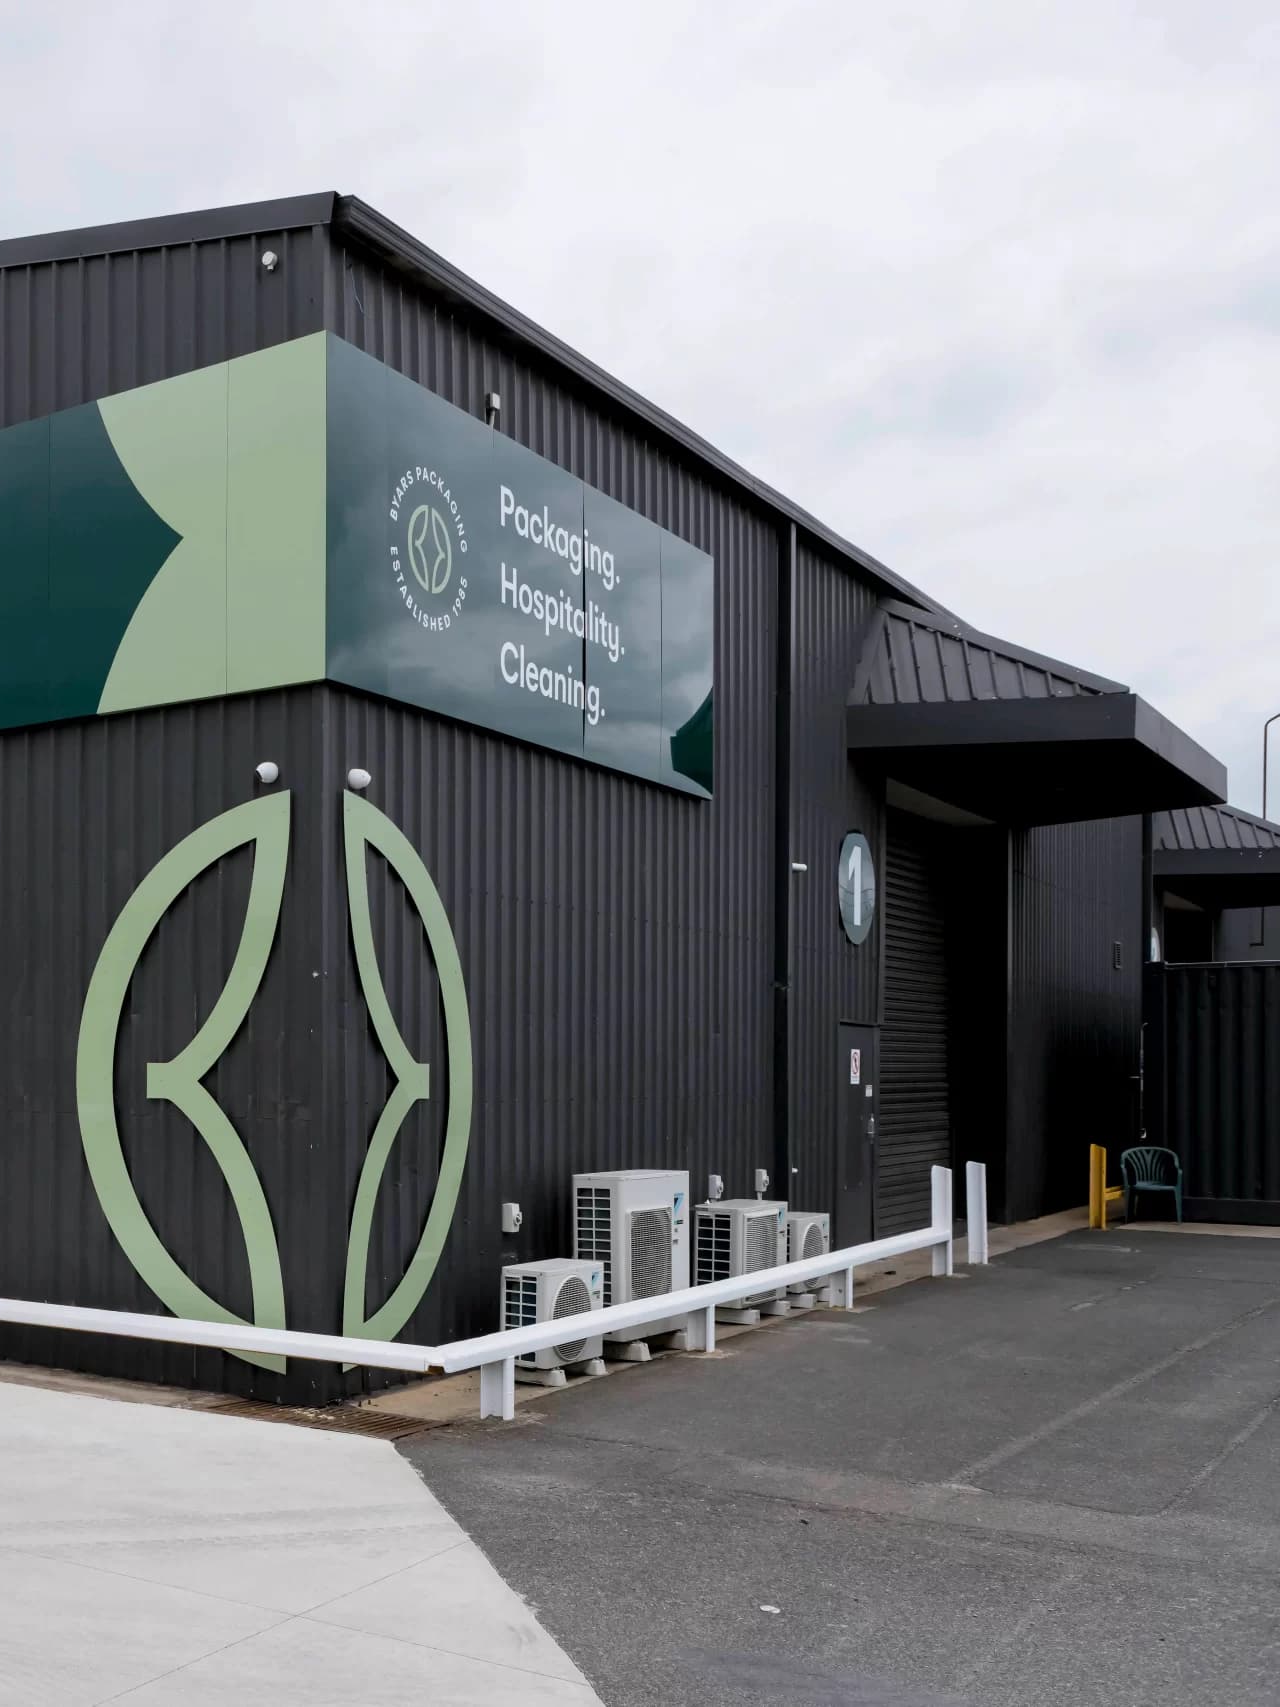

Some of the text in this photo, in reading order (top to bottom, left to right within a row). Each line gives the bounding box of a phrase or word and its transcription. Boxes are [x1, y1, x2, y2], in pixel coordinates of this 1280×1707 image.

[389, 466, 468, 553] BYARS PACKAGING
[499, 485, 621, 591] Packaging.
[389, 546, 468, 632] ESTABLISHED 1985
[500, 562, 625, 663] Hospitality.
[499, 641, 606, 726] Cleaning.
[848, 845, 862, 926] 1
